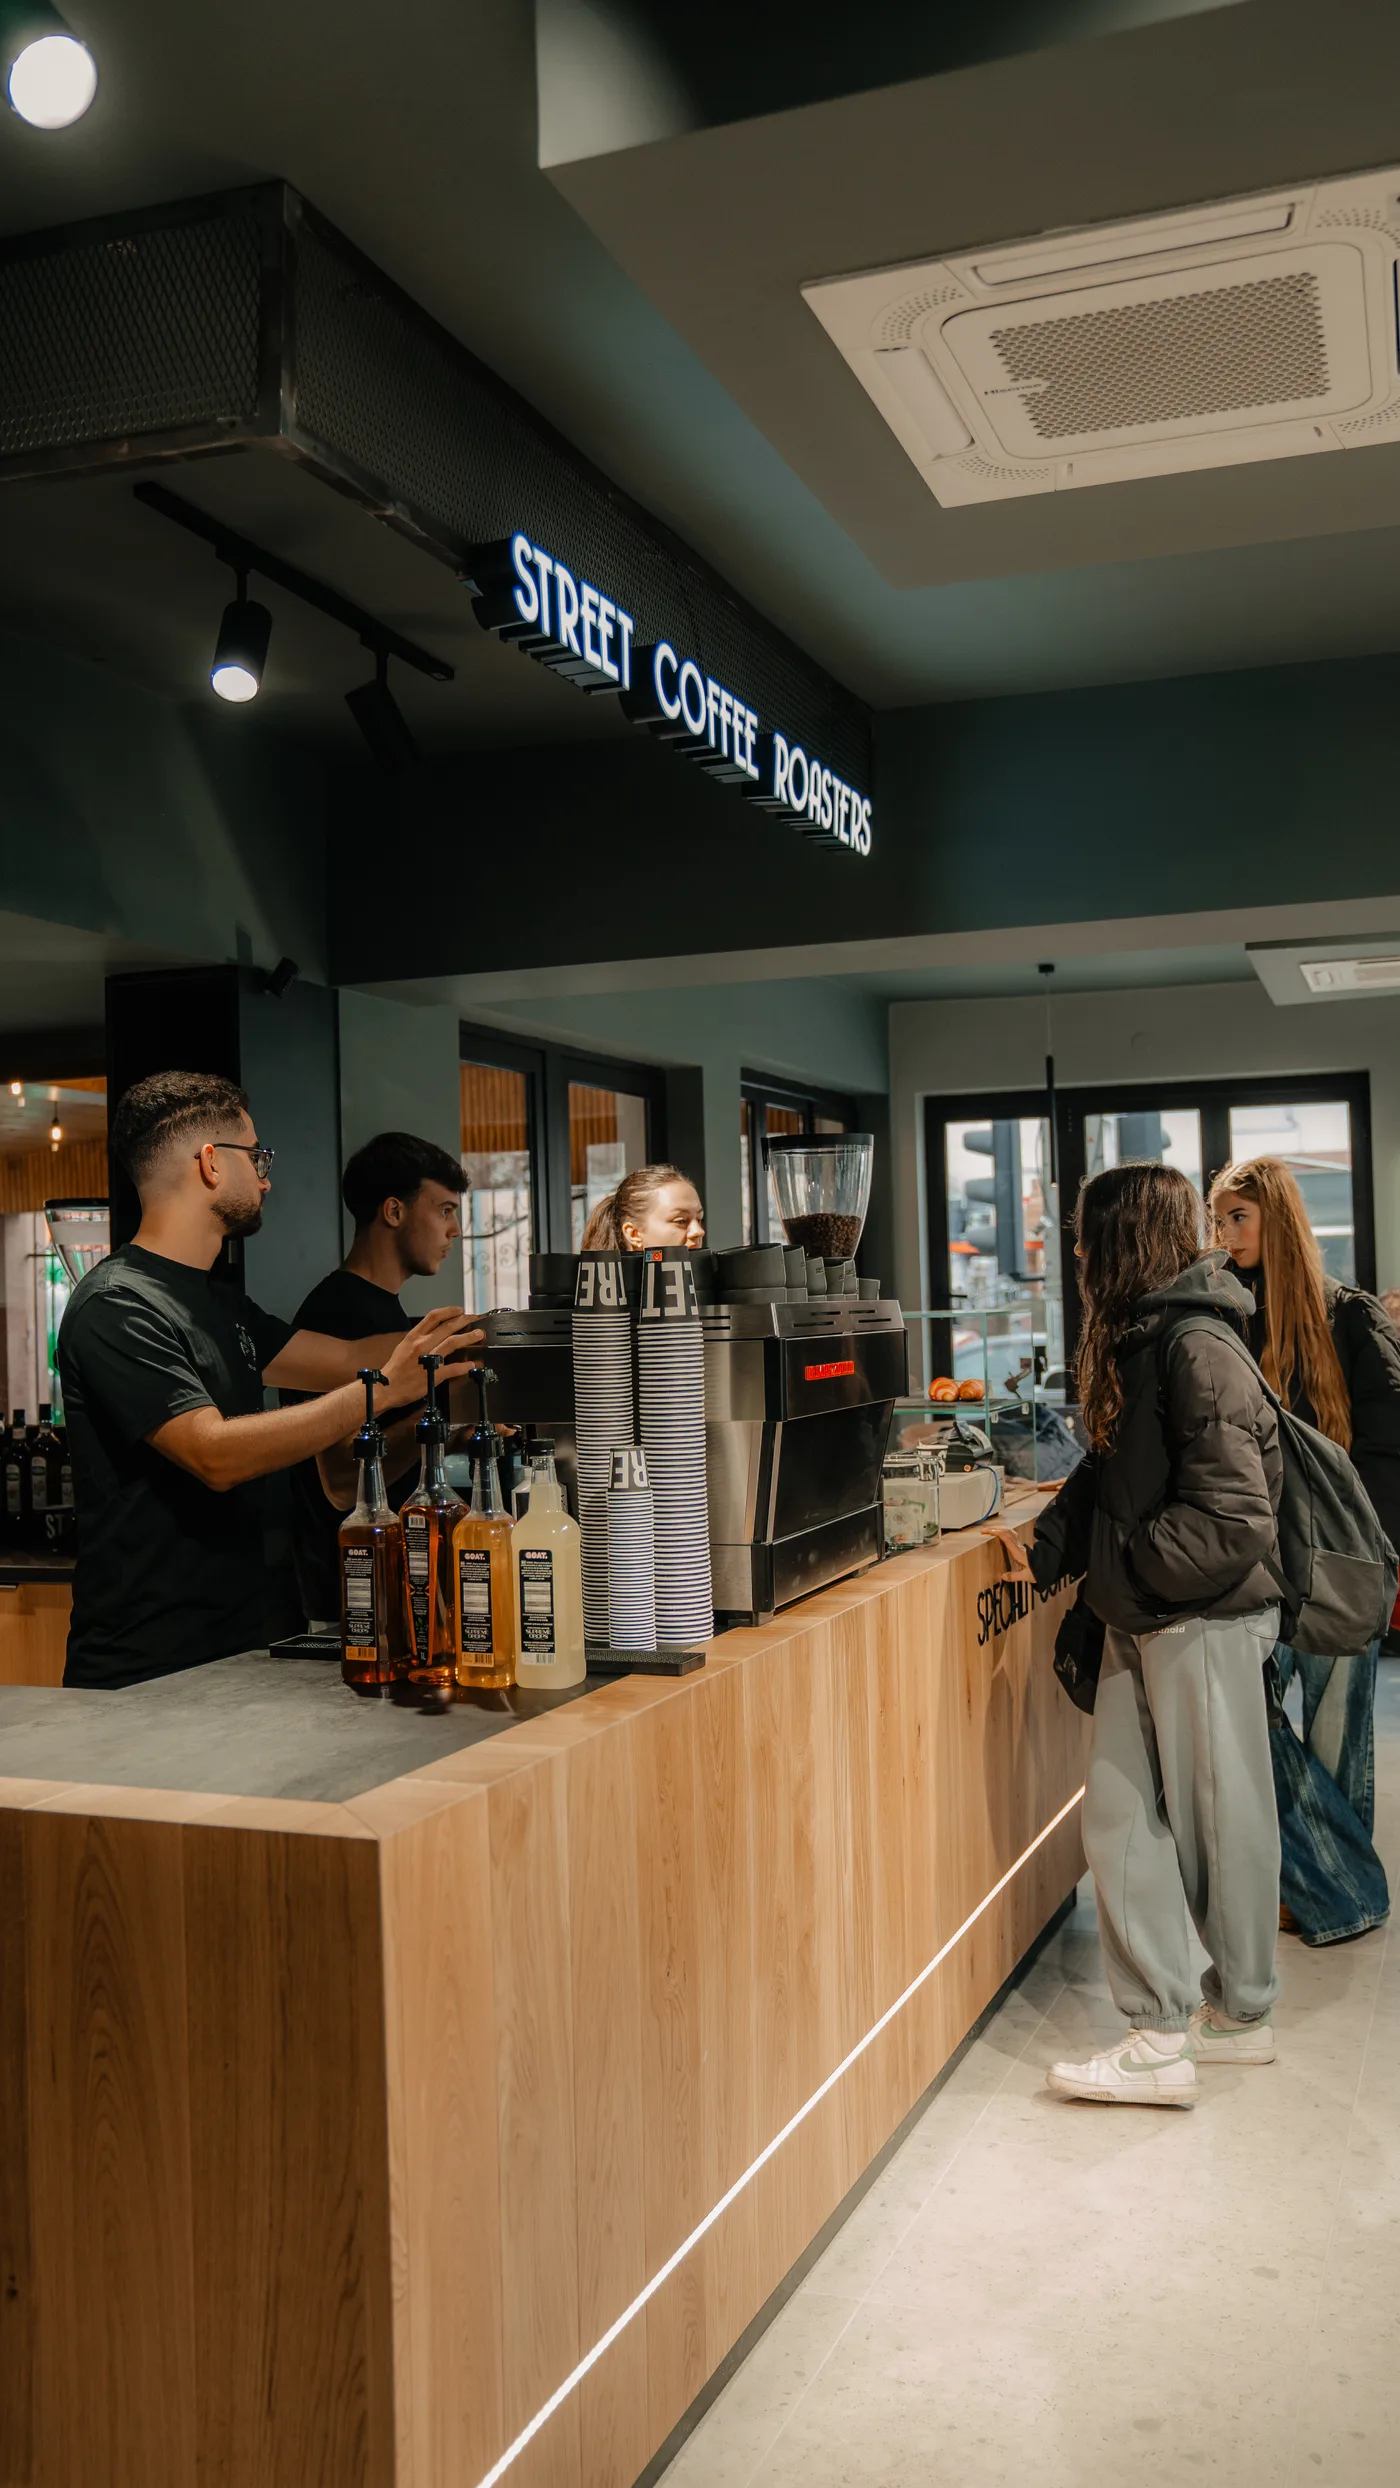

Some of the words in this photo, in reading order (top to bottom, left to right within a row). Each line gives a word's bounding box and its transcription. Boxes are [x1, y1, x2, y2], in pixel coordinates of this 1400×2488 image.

[512, 531, 634, 691] STREET
[654, 640, 760, 781] COFFEE
[773, 731, 872, 856] ROASTERS
[575, 1261, 628, 1307] TRE
[608, 1450, 648, 1489] RE
[348, 1548, 369, 1556] GOAT.
[464, 1552, 486, 1560] GOAT.
[525, 1551, 548, 1559] GOAT.
